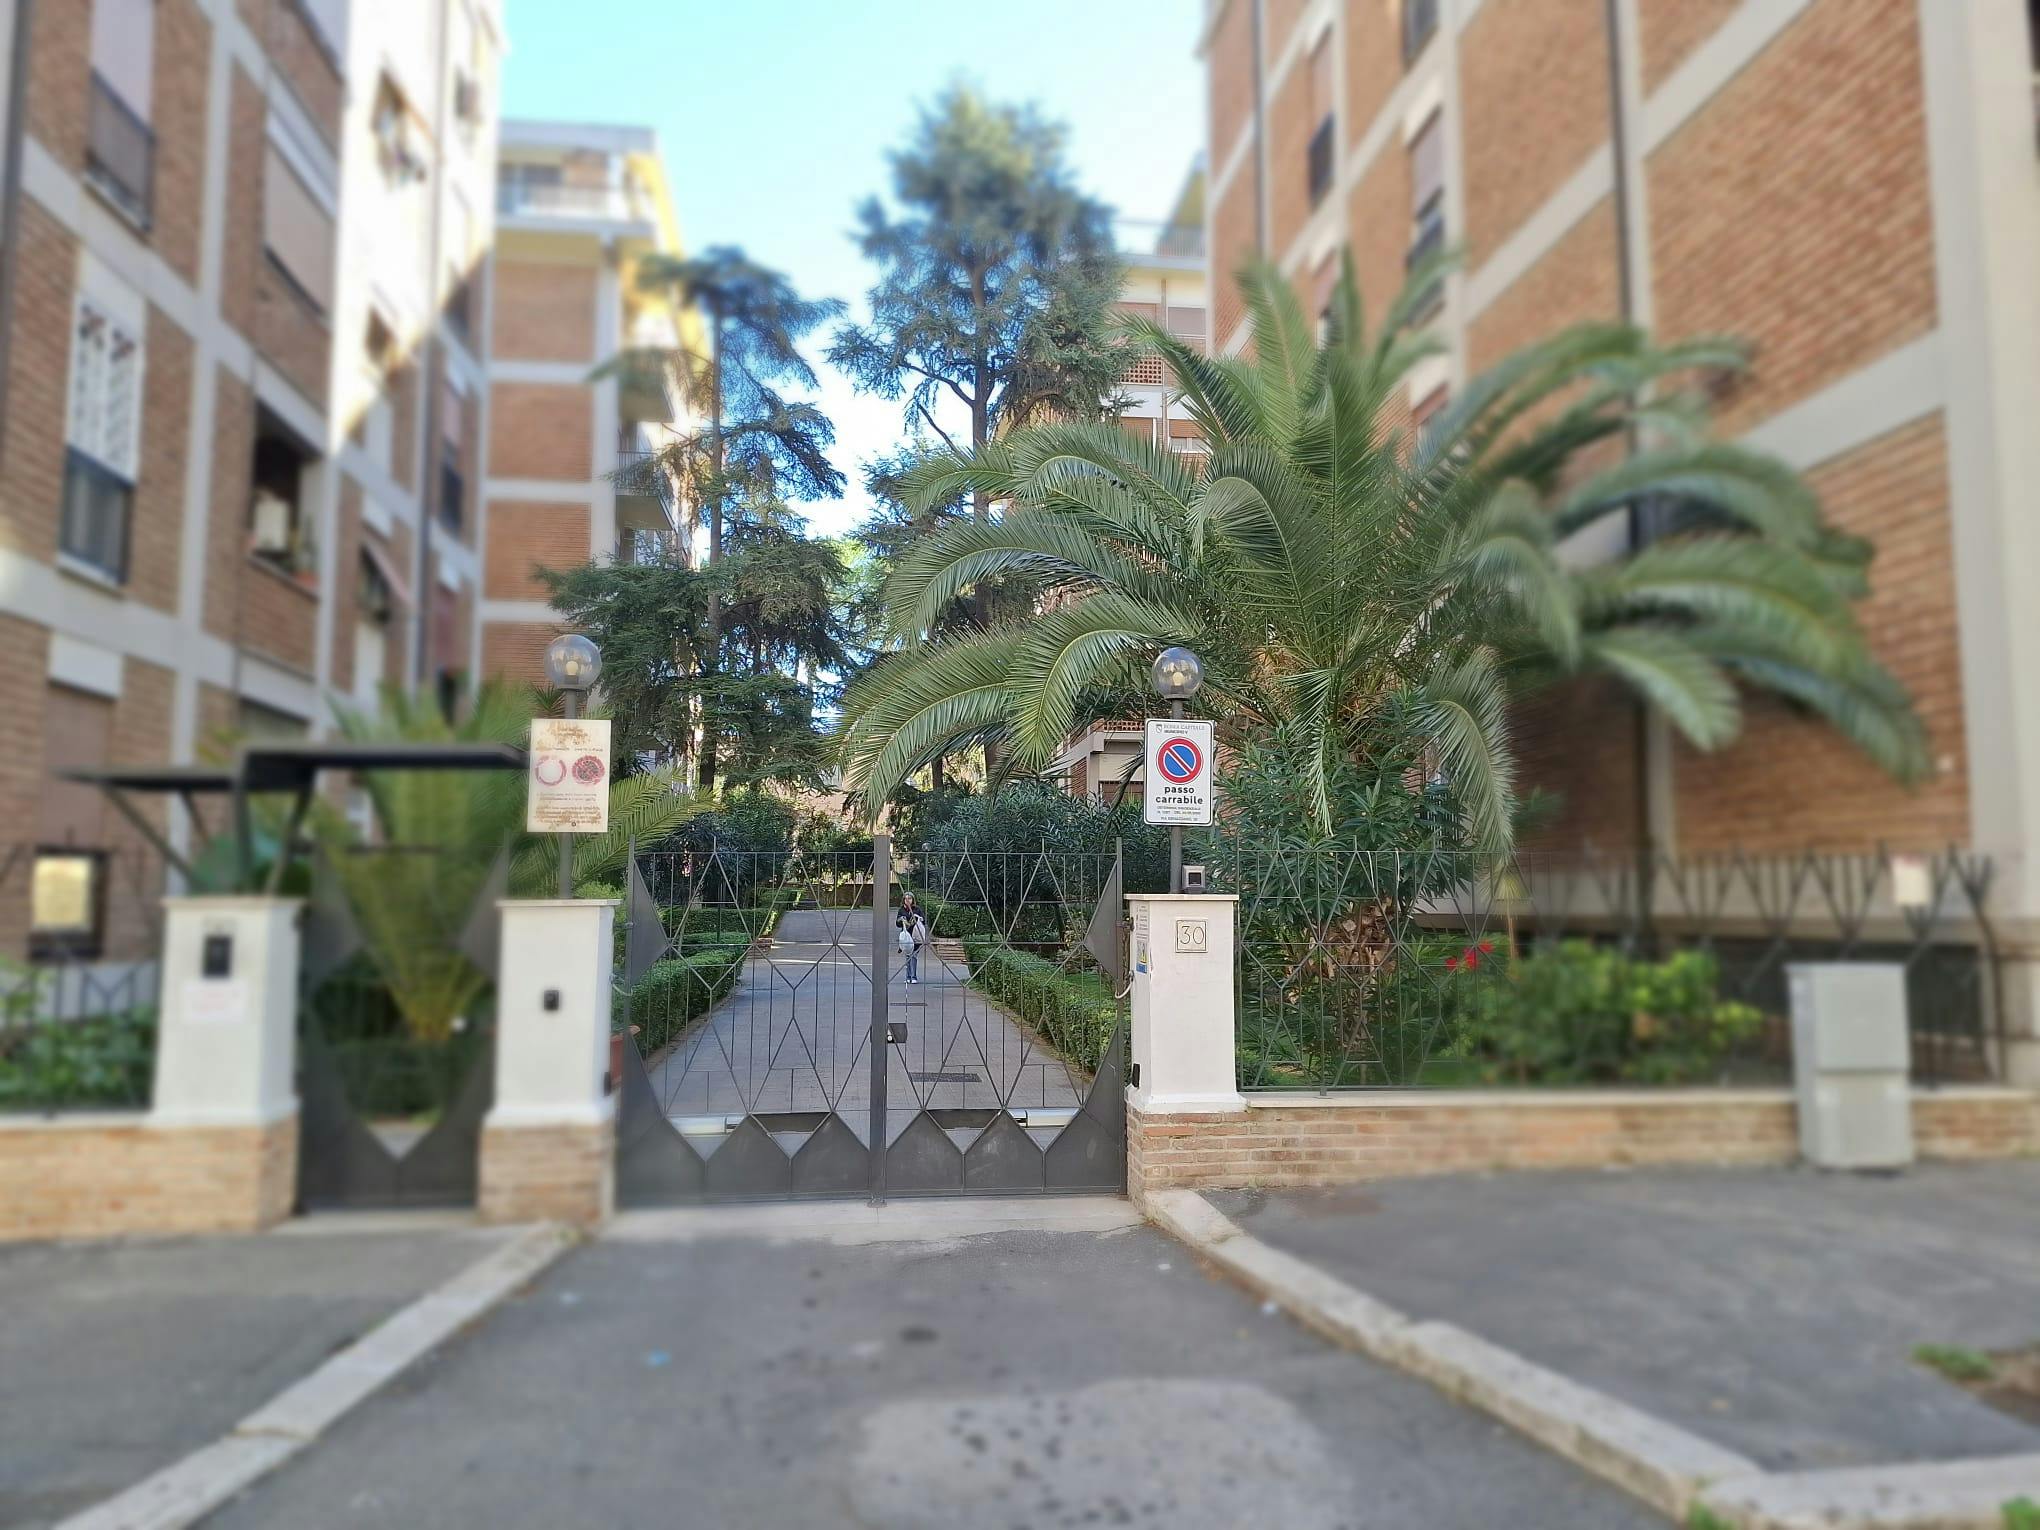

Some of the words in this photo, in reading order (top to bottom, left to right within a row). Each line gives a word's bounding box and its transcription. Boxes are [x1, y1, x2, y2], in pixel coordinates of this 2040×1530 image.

[1164, 786, 1195, 794] passo
[1155, 796, 1203, 804] carrabile
[1180, 925, 1205, 945] 30
